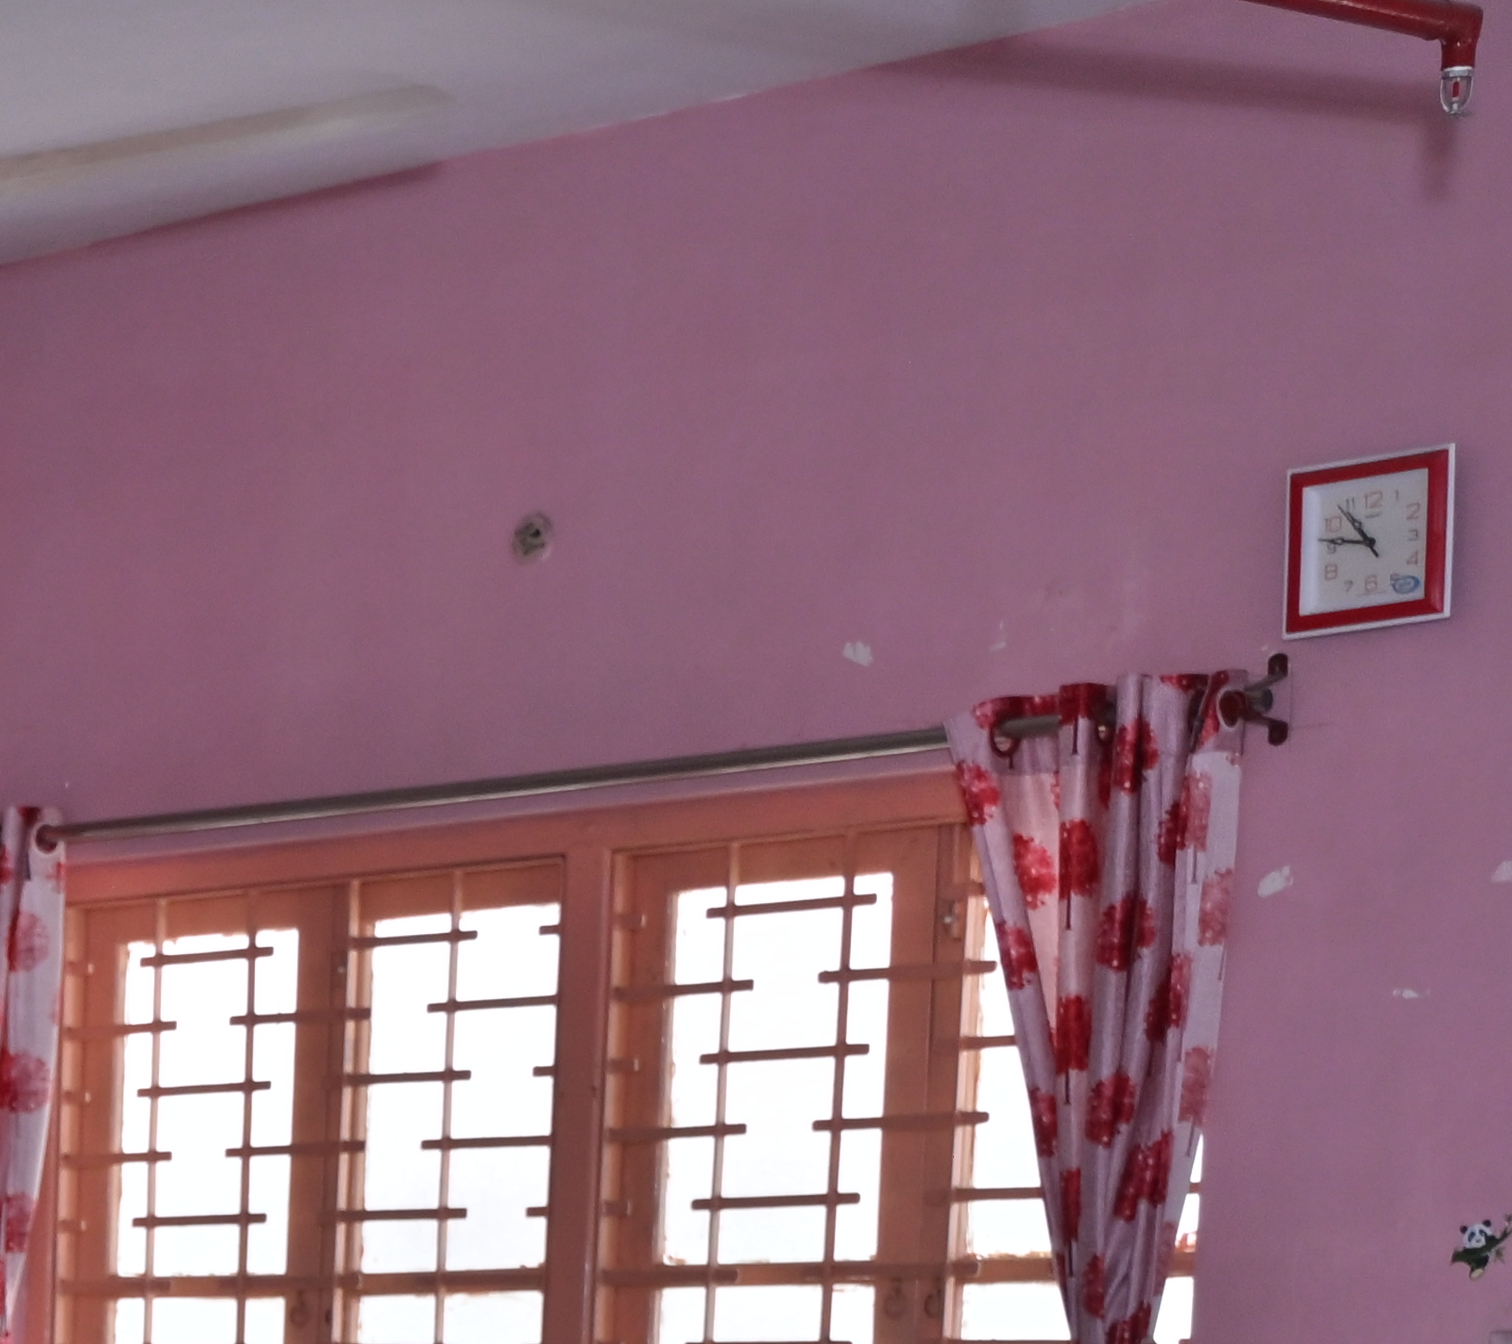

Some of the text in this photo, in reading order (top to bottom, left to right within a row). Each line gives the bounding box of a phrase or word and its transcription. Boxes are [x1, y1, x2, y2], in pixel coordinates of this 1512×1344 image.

[1365, 490, 1383, 509] 12
[1406, 502, 1421, 520] 2
[1325, 515, 1343, 533] 10
[1408, 528, 1419, 541] 3
[1406, 551, 1419, 565] 4
[1324, 563, 1338, 581] 8
[1364, 574, 1378, 593] 6
